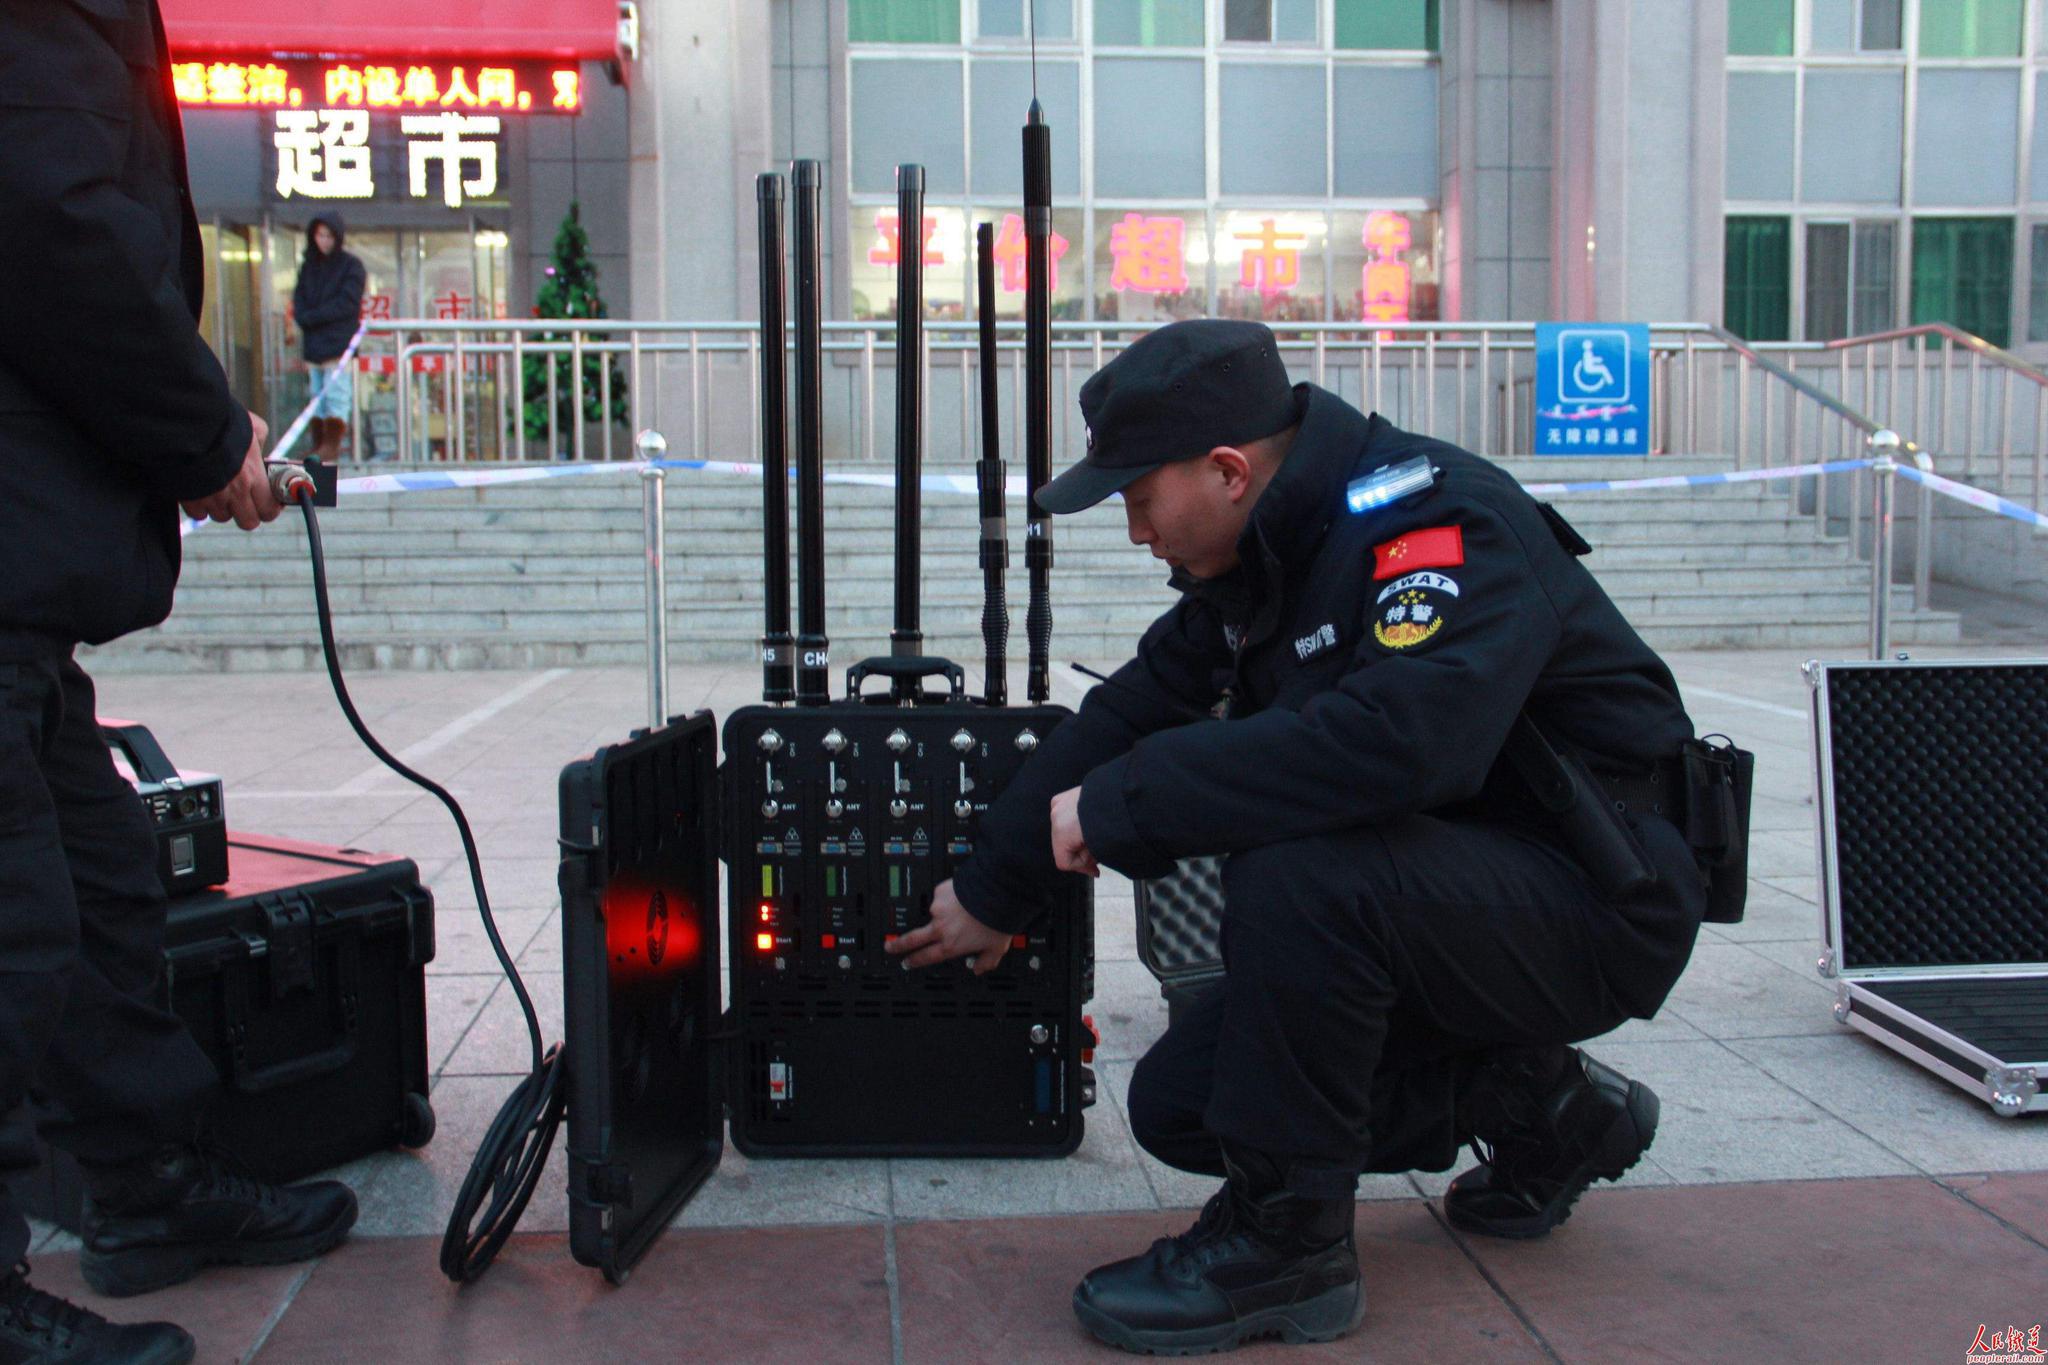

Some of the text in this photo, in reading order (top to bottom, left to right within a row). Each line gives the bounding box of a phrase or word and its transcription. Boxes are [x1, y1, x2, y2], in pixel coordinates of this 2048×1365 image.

[273, 109, 502, 207] 超市
[1026, 523, 1041, 537] H1
[1387, 574, 1449, 594] SWAT
[1385, 603, 1433, 623] 特警
